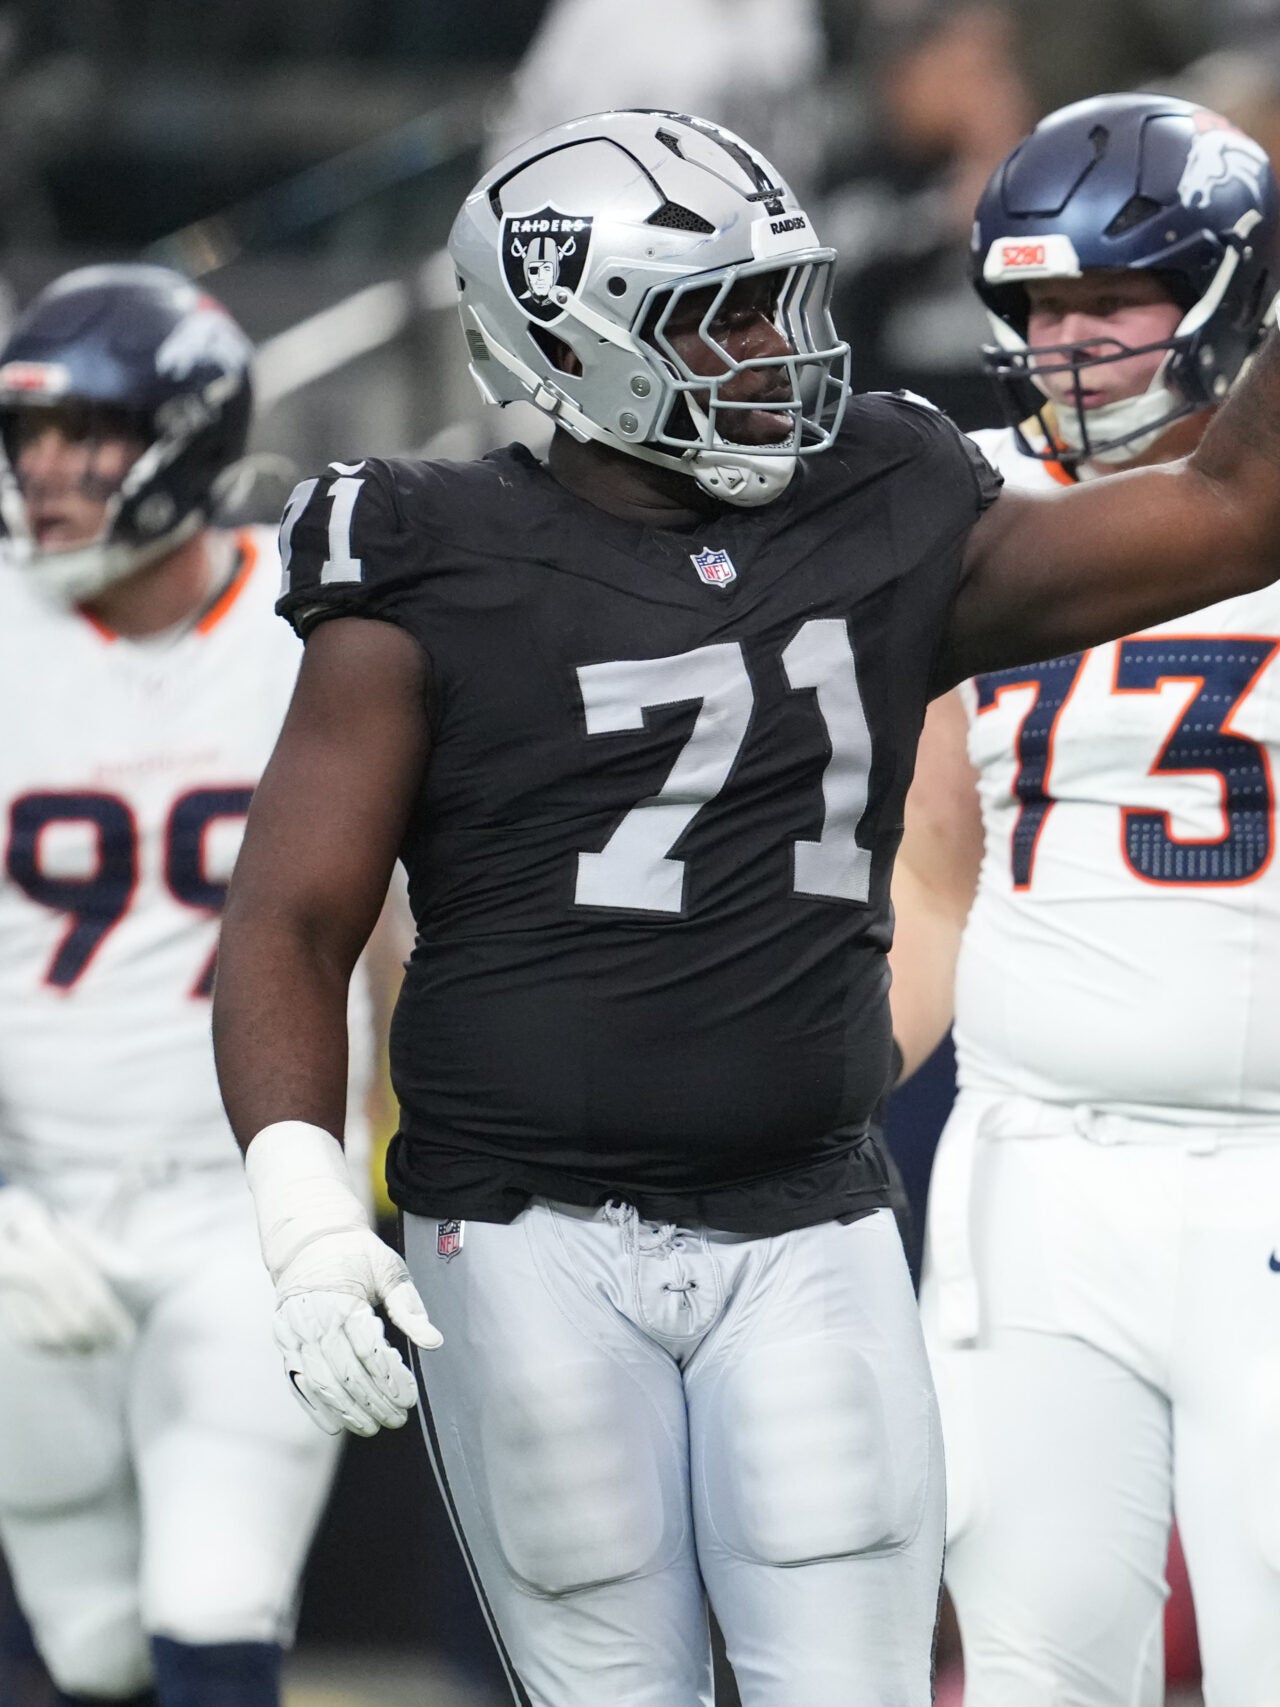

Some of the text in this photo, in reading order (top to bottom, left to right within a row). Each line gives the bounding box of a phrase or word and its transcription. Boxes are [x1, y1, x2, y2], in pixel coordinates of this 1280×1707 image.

[511, 219, 584, 233] RAIDERS
[770, 216, 806, 235] RAIDERS
[703, 563, 731, 580] NFL
[574, 618, 873, 913] 71
[439, 1234, 458, 1254] NFL
